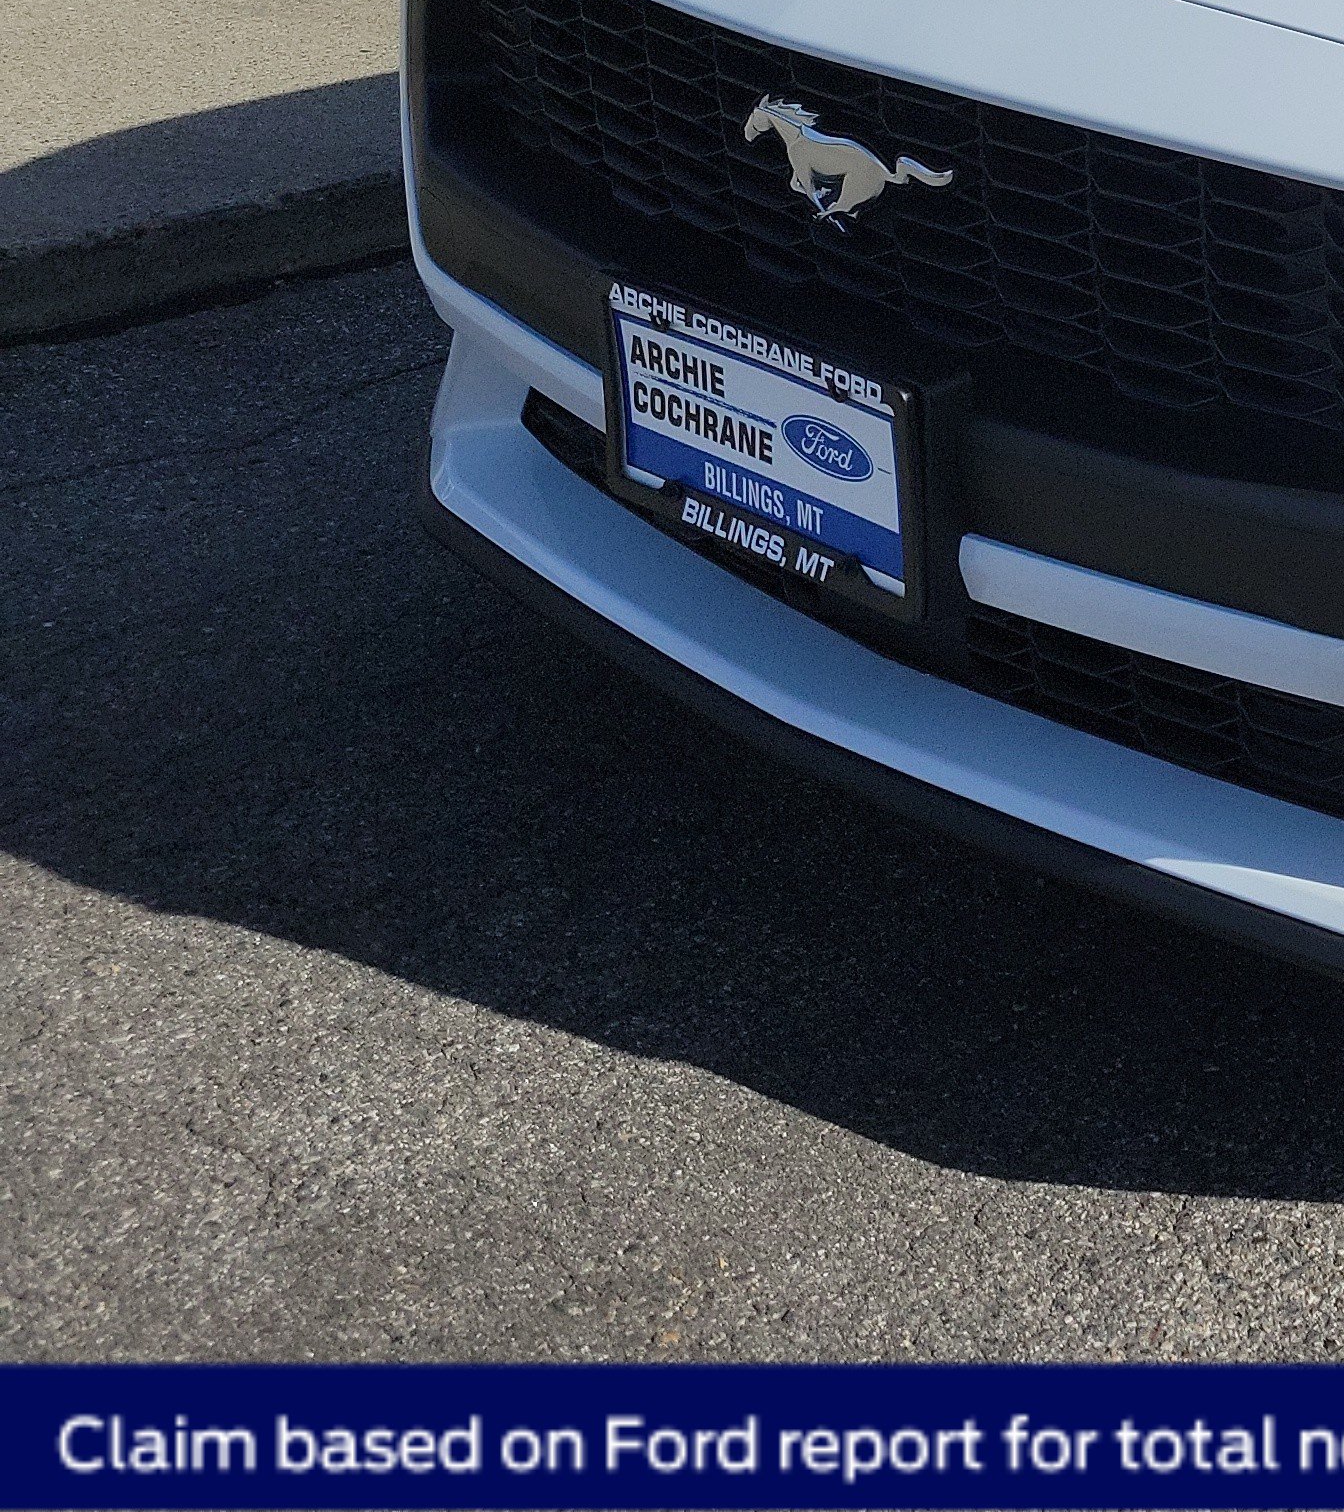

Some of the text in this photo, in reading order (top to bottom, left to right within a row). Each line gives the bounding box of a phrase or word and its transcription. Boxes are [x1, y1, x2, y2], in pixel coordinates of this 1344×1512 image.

[609, 282, 882, 402] ARCHIE COCHRANE FORD
[630, 334, 726, 399] ARCHIE
[633, 380, 774, 465] COCHRANE
[800, 424, 853, 472] Ford
[704, 461, 824, 535] BILLINGS, MT
[682, 497, 835, 583] BILLINGS, MT
